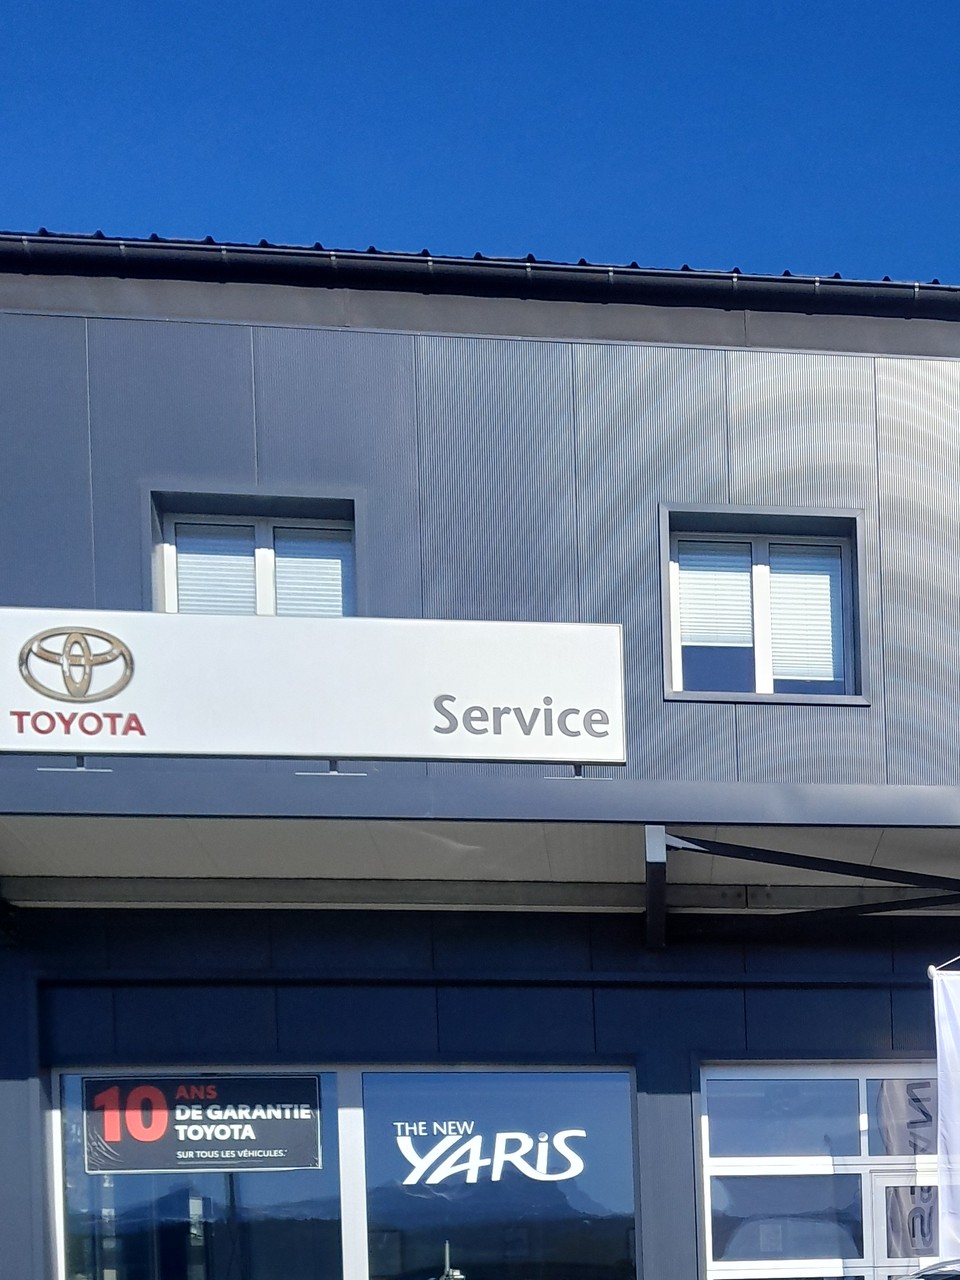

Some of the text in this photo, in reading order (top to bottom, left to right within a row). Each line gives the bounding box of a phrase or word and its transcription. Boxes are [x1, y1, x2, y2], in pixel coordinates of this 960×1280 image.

[9, 710, 146, 736] TOYOTA
[433, 694, 610, 738] Service
[175, 1085, 217, 1100] ANS
[94, 1084, 169, 1143] 10
[175, 1104, 312, 1121] DE GARANTIE
[175, 1124, 256, 1141] TOYOTA
[393, 1120, 475, 1136] THE NEW
[176, 1150, 195, 1159] SUR
[195, 1150, 219, 1158] TOUS
[221, 1150, 236, 1158] LES
